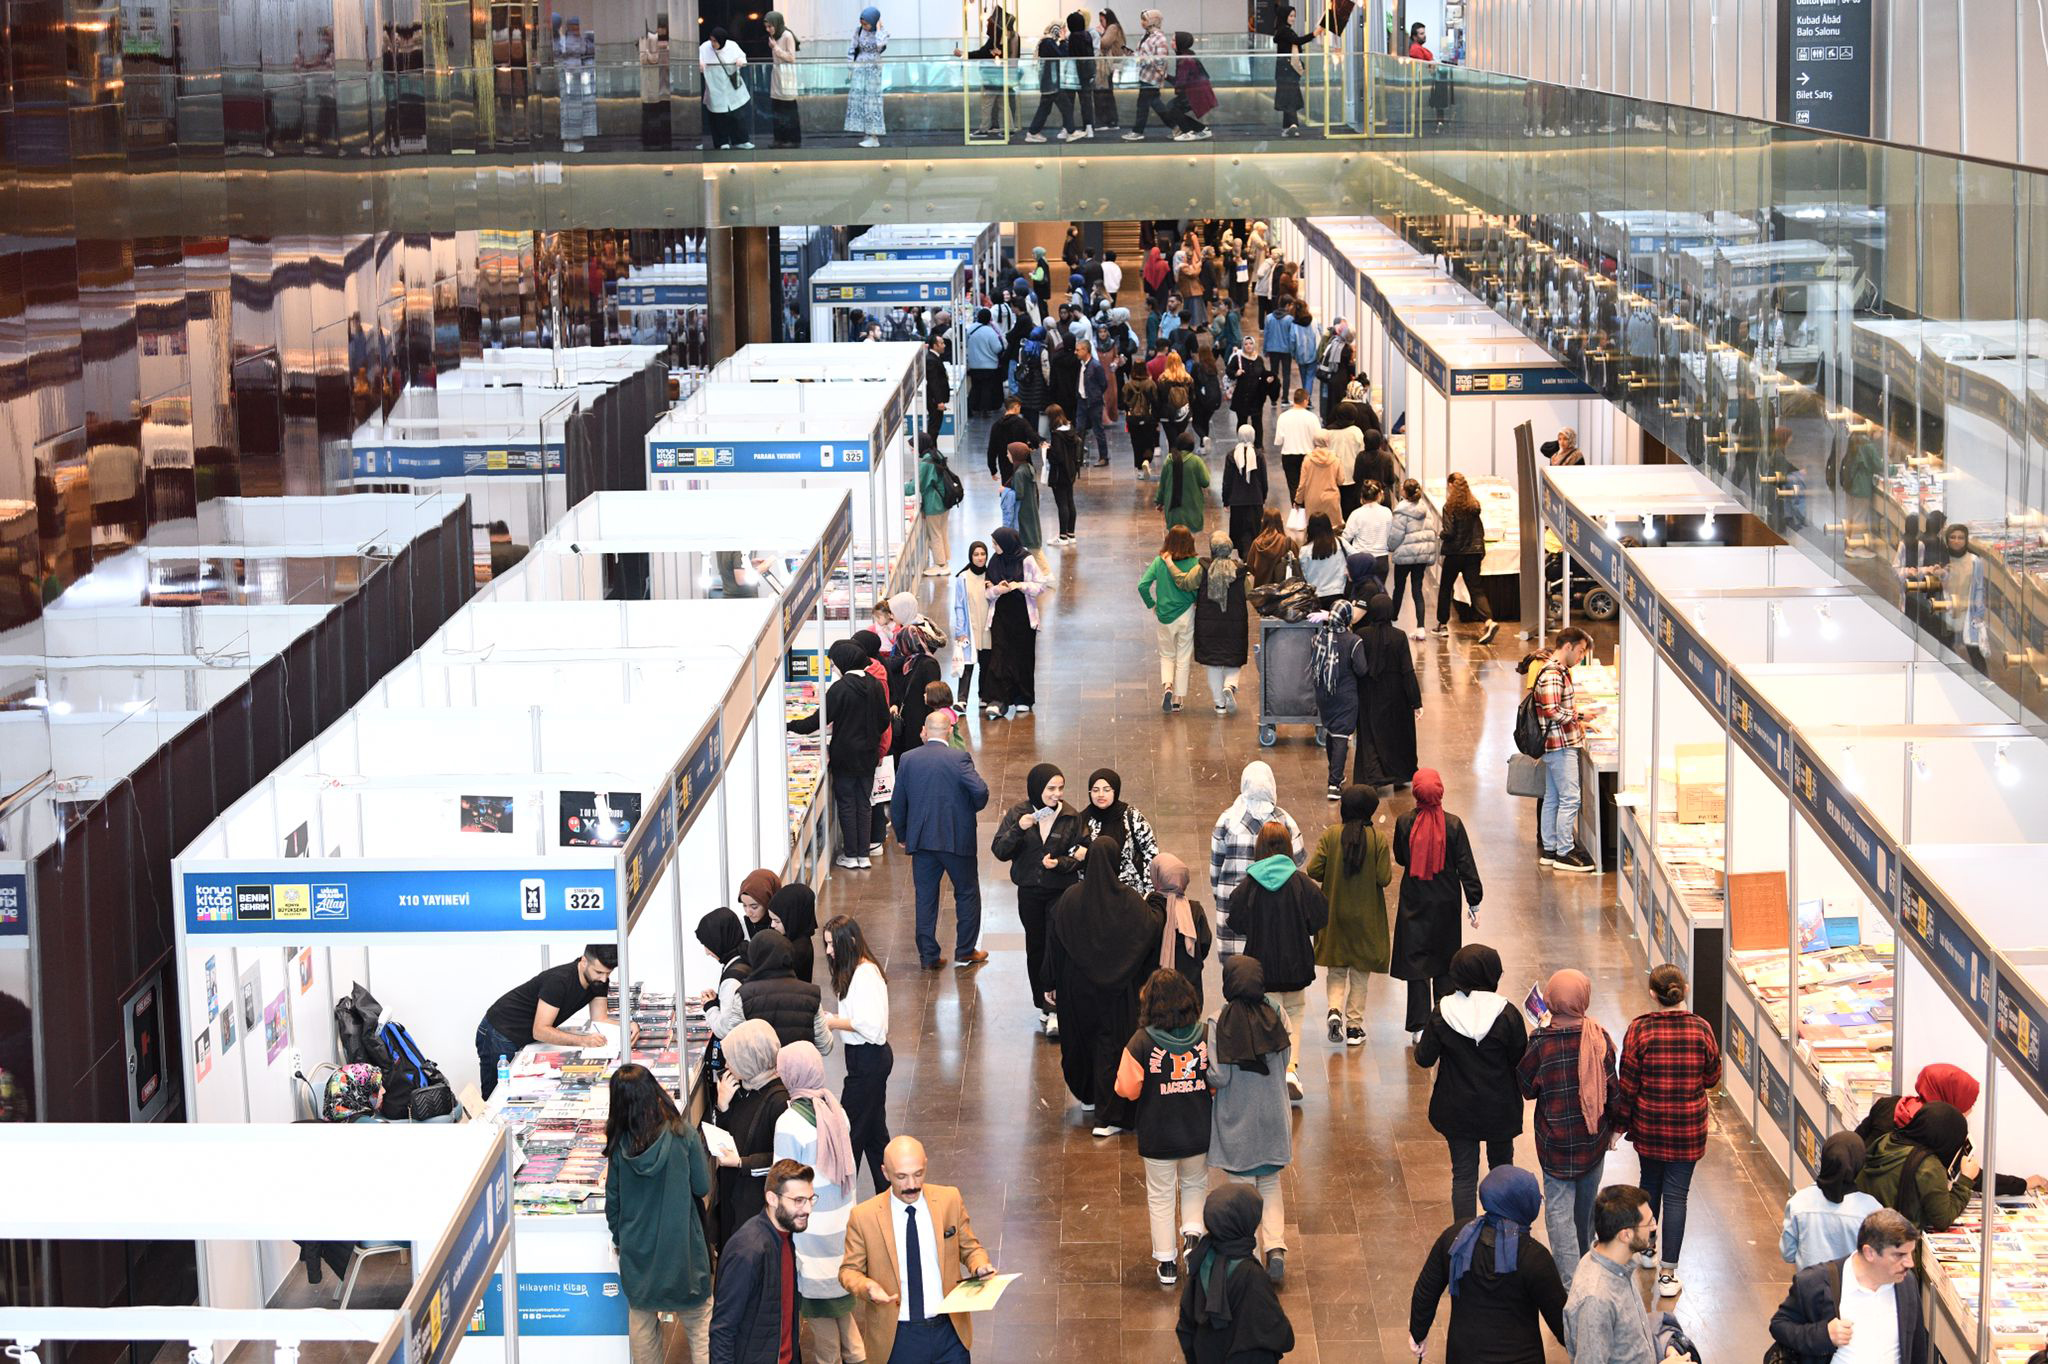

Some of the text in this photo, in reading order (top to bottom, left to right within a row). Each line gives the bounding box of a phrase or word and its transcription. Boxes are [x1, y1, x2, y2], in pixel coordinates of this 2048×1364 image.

[1796, 15, 1821, 25] Kubad
[1796, 27, 1840, 36] Balo Salonu
[1796, 90, 1833, 100] Bilet Satış
[845, 453, 861, 462] 325
[196, 885, 232, 897] konya
[196, 894, 233, 908] kitap
[399, 892, 470, 906] X10 YAYINEVİ
[570, 894, 600, 909] 322
[562, 1283, 588, 1294] Kitap
